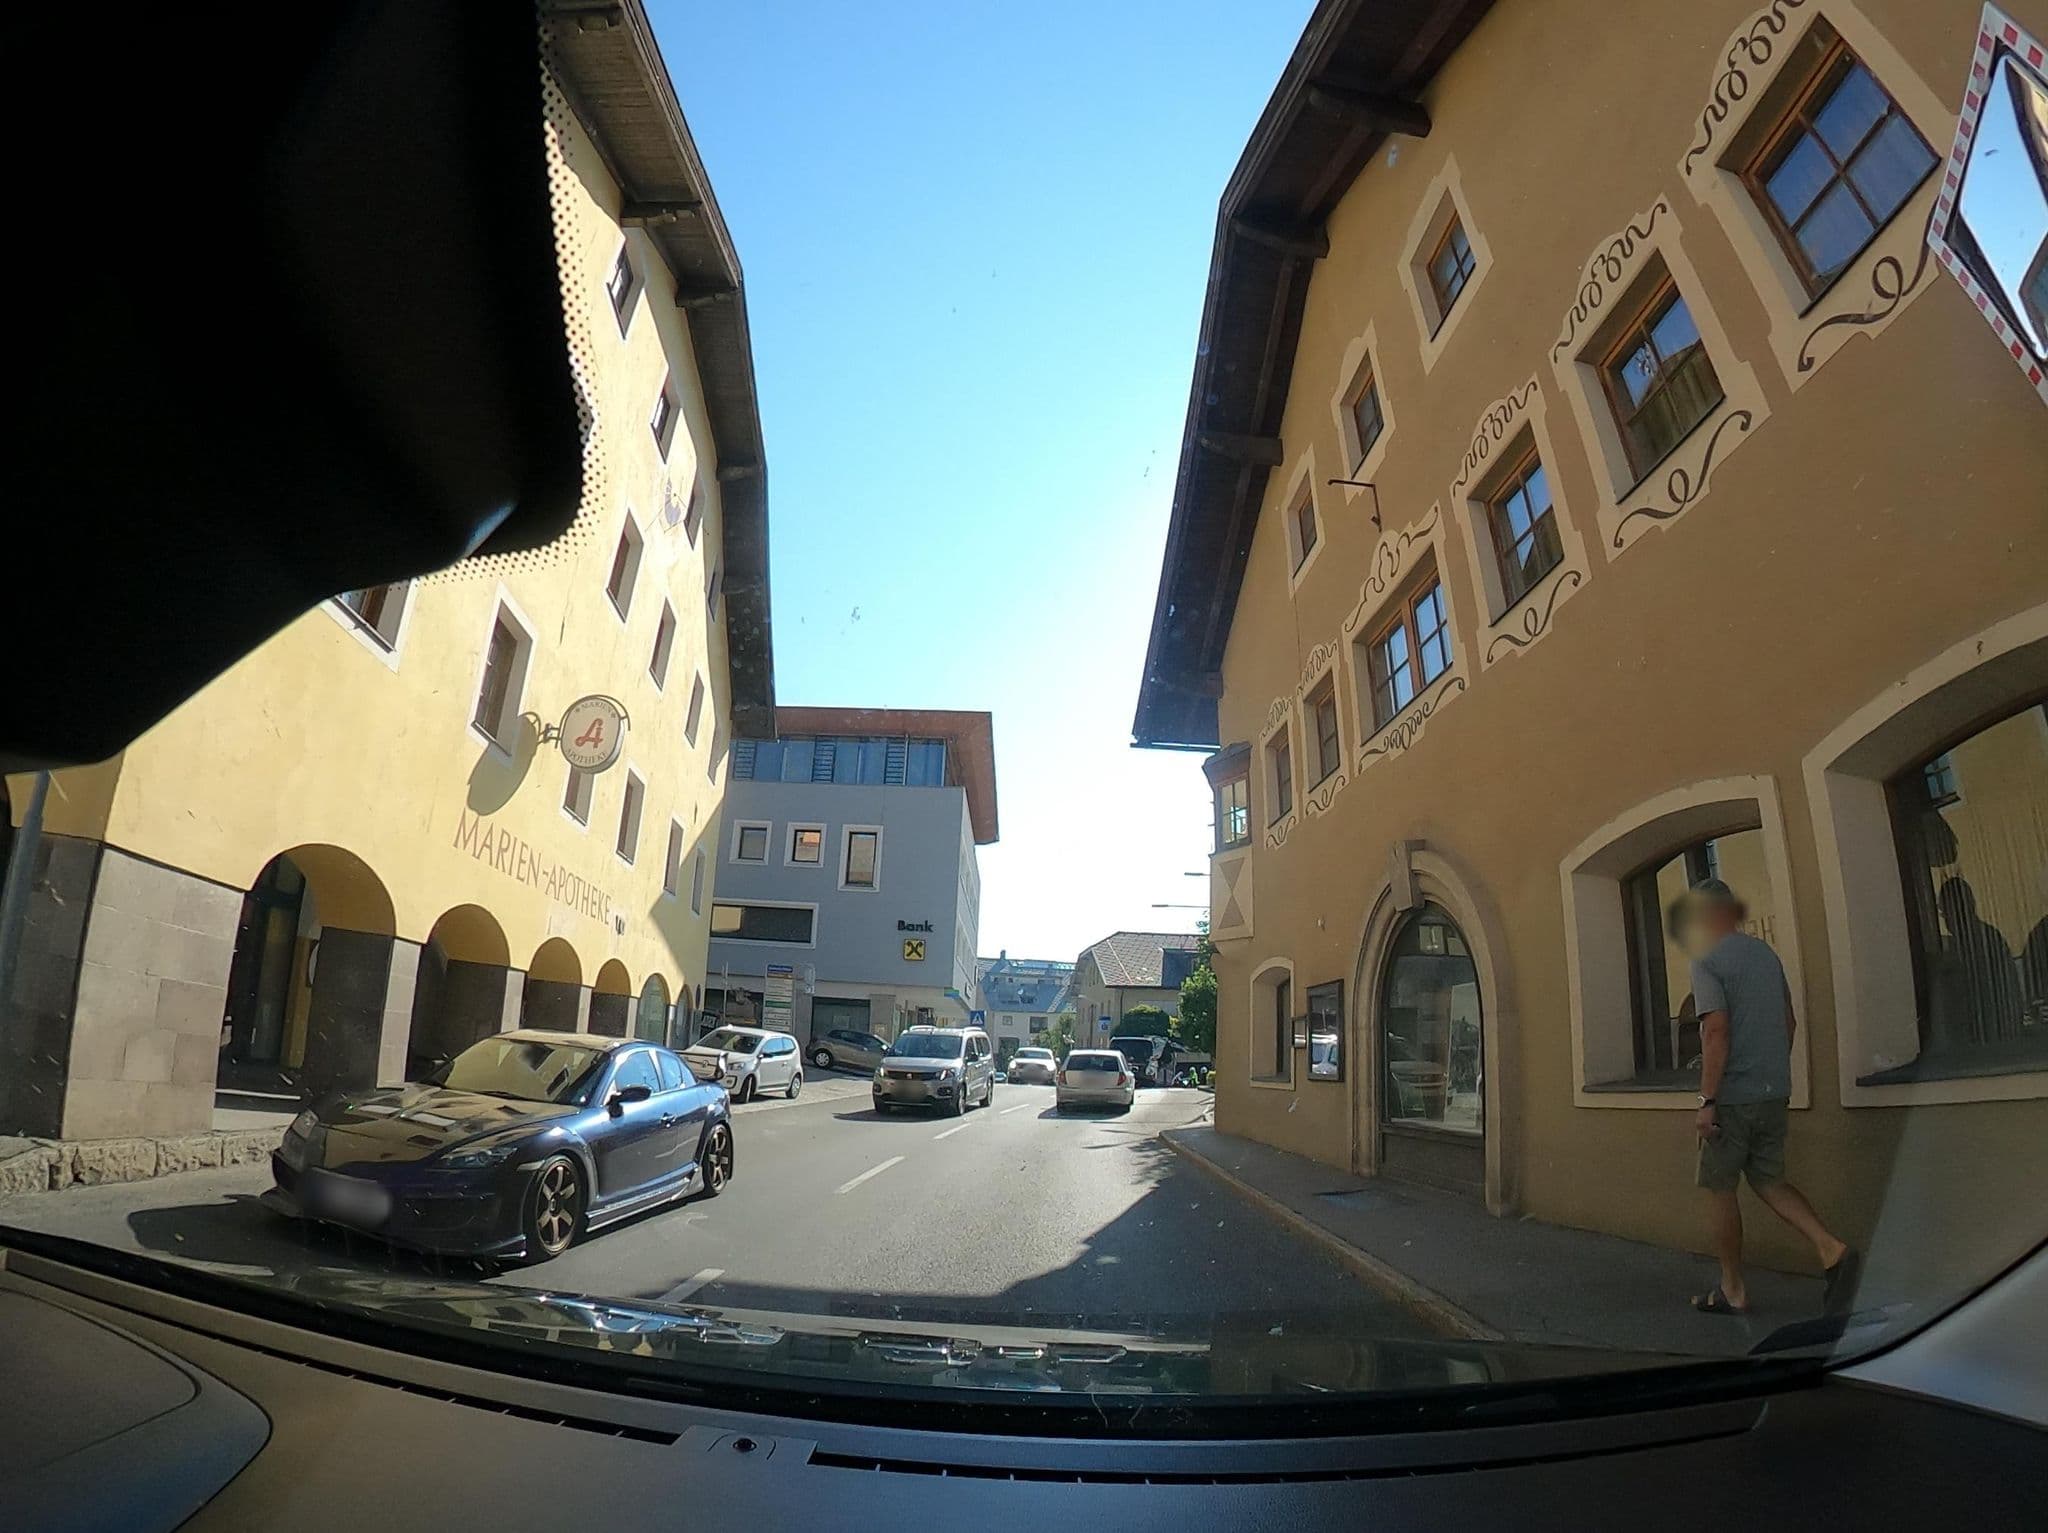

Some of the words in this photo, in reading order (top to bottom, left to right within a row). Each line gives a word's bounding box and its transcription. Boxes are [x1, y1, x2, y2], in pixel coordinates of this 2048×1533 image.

[575, 718, 604, 749] A
[452, 807, 612, 925] MARIEN-APOTHEKE
[897, 920, 934, 933] Bank
